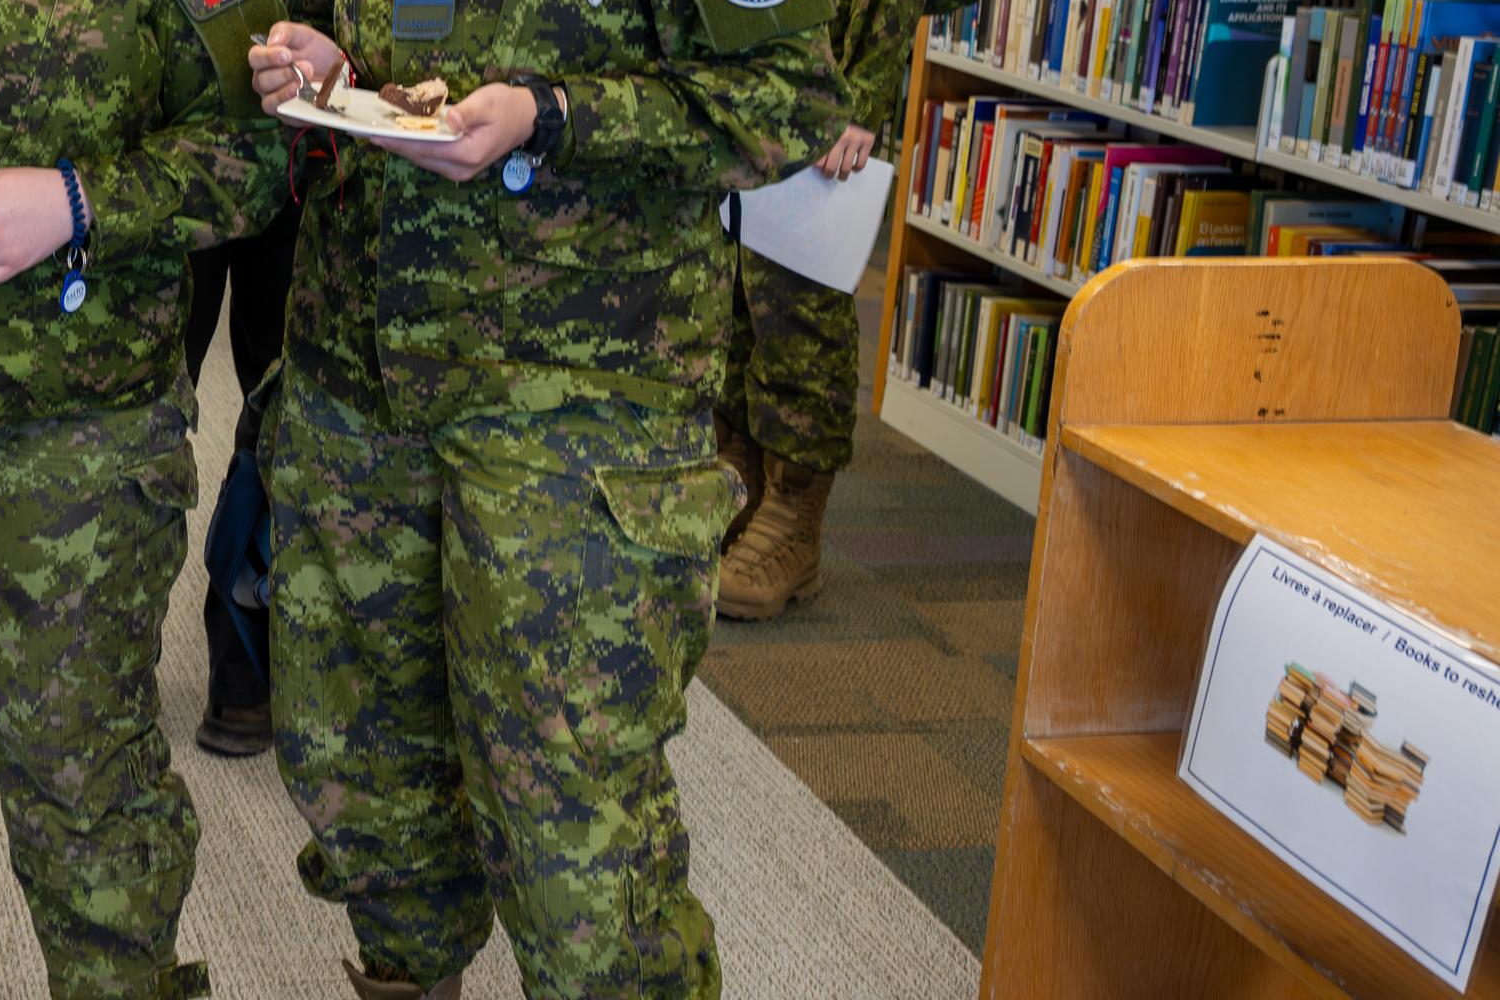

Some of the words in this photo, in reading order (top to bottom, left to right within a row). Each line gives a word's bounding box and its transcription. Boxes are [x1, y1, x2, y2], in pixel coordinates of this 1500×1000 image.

[1256, 3, 1274, 12] AND
[1276, 4, 1287, 12] ITS
[1272, 565, 1309, 597] Livres
[1311, 590, 1322, 604] à
[1322, 597, 1378, 636] replacer
[1381, 630, 1392, 642] /
[1395, 637, 1441, 673] Books
[1443, 665, 1460, 684] to
